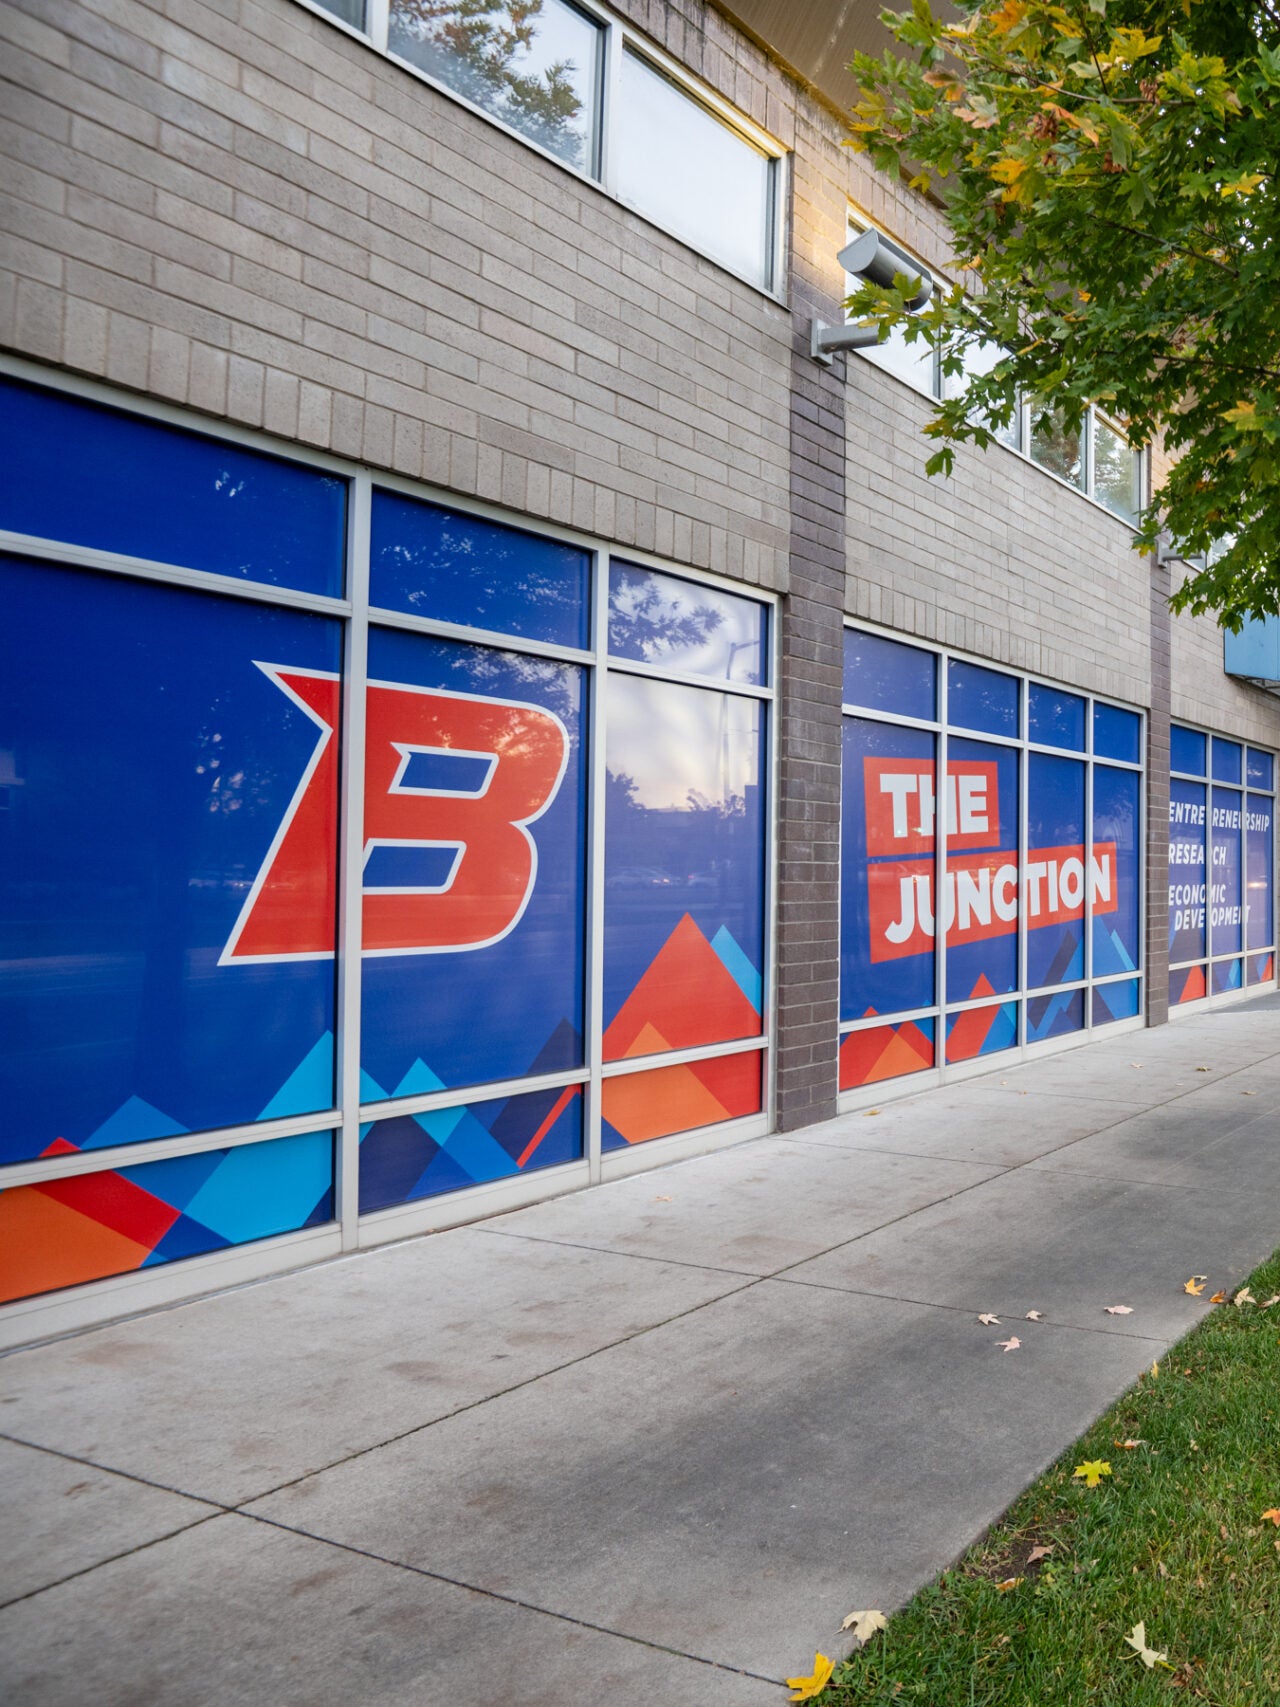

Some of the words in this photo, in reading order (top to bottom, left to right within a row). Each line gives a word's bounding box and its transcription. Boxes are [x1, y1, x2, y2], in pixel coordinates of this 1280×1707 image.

[880, 773, 989, 839] THE
[1169, 801, 1270, 832] ENTRERENERSHIP
[1168, 843, 1227, 866] RESEACH
[884, 853, 1111, 944] JUNCTION
[1174, 905, 1251, 931] DEVEOPMET
